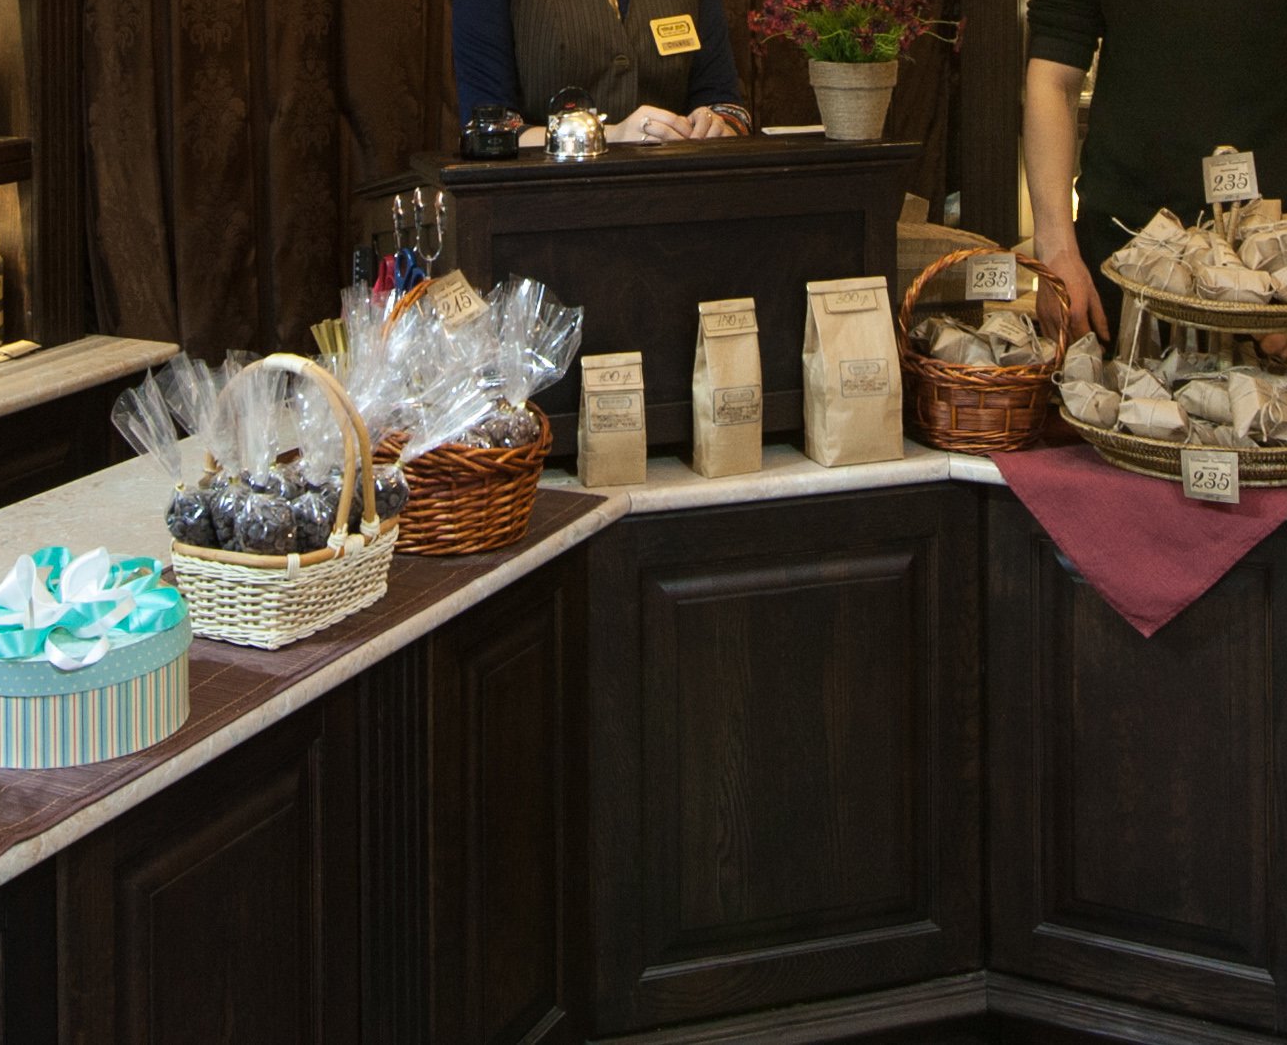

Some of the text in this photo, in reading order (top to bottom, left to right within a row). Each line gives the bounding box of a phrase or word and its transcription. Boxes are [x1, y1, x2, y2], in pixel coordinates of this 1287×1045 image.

[1212, 171, 1250, 192] 235
[972, 270, 1009, 289] 235
[442, 291, 472, 319] 215
[1192, 470, 1231, 491] 235
